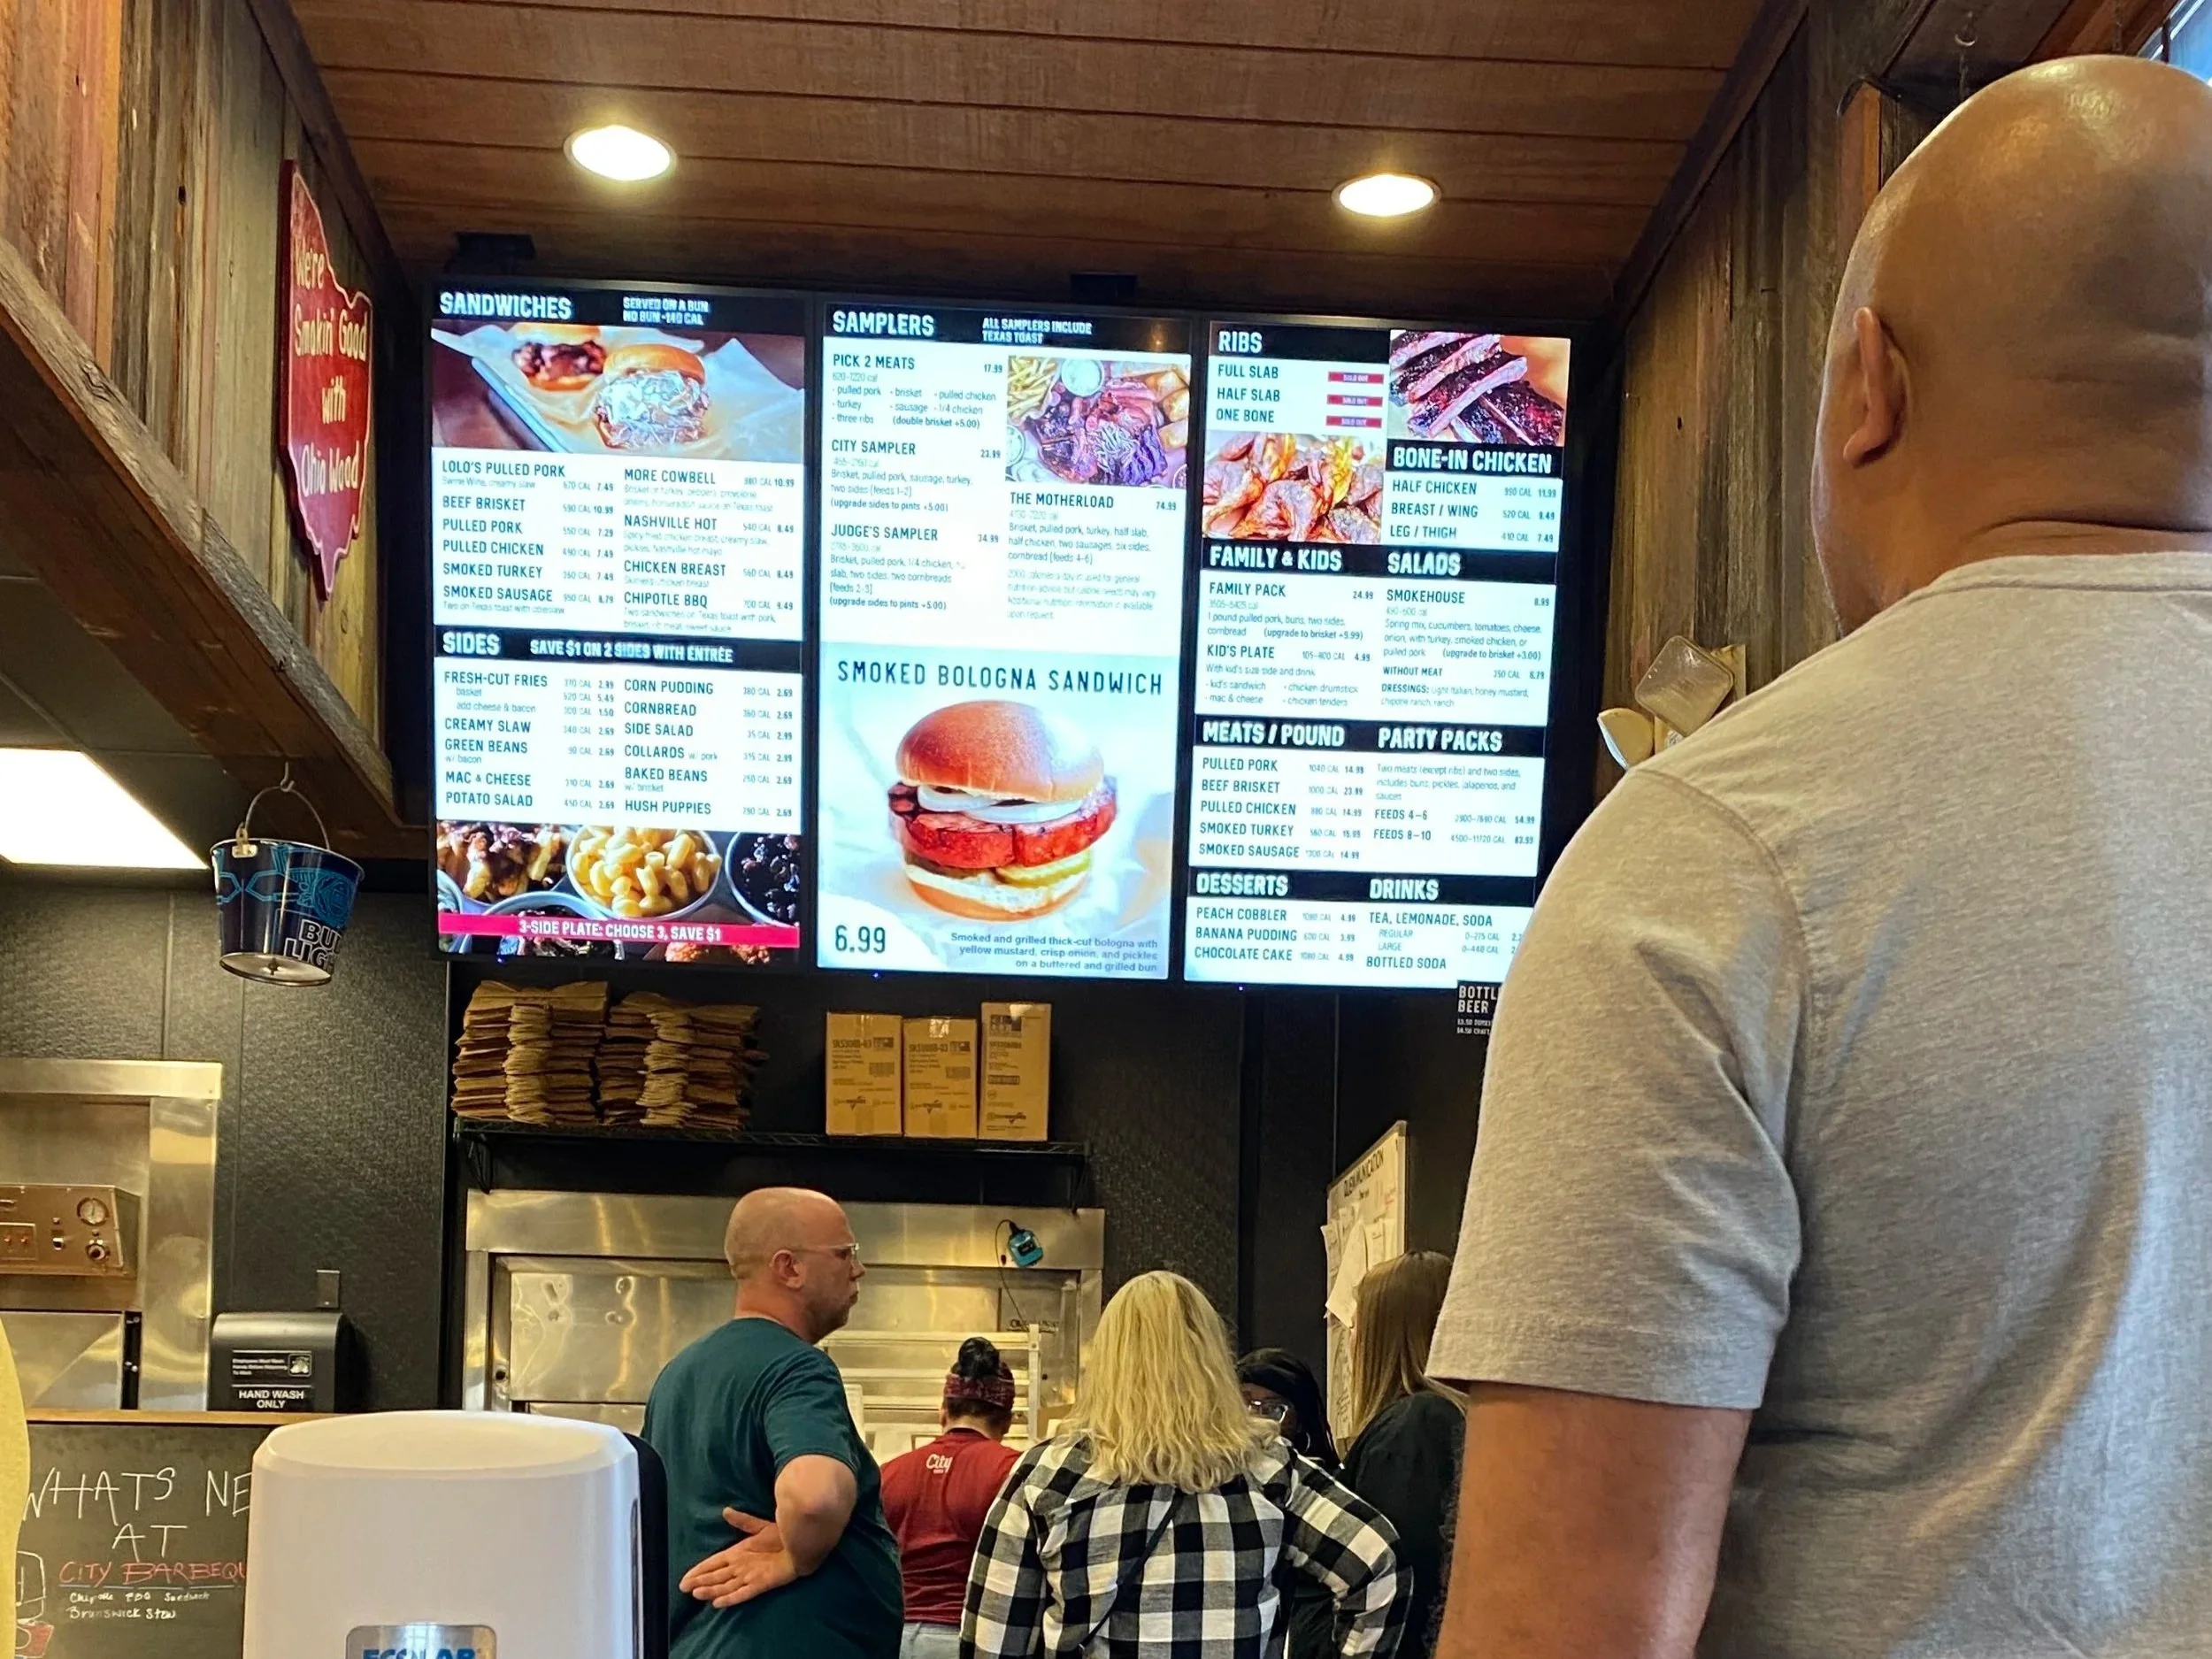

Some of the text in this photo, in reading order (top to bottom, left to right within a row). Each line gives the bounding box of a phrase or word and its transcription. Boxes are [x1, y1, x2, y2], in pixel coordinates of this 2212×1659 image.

[440, 292, 572, 319] SANDWICHES
[833, 311, 1091, 336] SAMPLERS ALL SAMPLERS INCLUDE
[339, 309, 367, 361] Good
[983, 330, 1042, 344] TEXAS TOAST
[1218, 331, 1263, 353] RIBS
[833, 354, 915, 370] PICK 2 MEATS
[1218, 365, 1279, 379] FULL SLAB
[322, 375, 346, 424] with
[1217, 388, 1279, 402] HALF SLAB
[1217, 408, 1274, 423] ONE BONE
[832, 440, 916, 455] CITY SAMPLER
[1394, 447, 1551, 473] BONE-IN CHICKEN
[301, 441, 359, 497] Ohio Wood
[442, 460, 565, 477] LOLO'S PULLED PORK
[625, 469, 716, 484] MORE COWBELL
[1393, 480, 1477, 495] HALF CHICKEN
[442, 495, 526, 511] BEEF BRISKET
[1010, 492, 1031, 504] THE
[1036, 493, 1114, 508] MOTHERLOAD
[1391, 503, 1478, 518] BREAST WING
[443, 518, 523, 534] PULLED PORK
[625, 515, 717, 530] NASHVILLE HOT
[832, 525, 938, 541] JUDGE'S SAMPLER
[1390, 526, 1456, 539] LEG THIGH
[443, 539, 543, 556] PULLED CHICKEN
[1210, 545, 1342, 571] FAMILY & KIDS
[1387, 551, 1461, 576] SALADS
[443, 563, 542, 579] SMOKED TURKEY
[624, 560, 726, 575] CHICKEN BREAST
[443, 586, 553, 602] SMOKED SAUSAGE
[1210, 582, 1286, 597] FAMILY PACK
[1386, 589, 1465, 603] SMOKEHOUSE
[624, 592, 708, 609] CHIPOTLE BBQ
[442, 632, 500, 655] SIDES
[530, 639, 565, 655] SAVE
[565, 640, 580, 657] $1
[583, 641, 602, 656] ON
[604, 641, 613, 657] 2
[615, 641, 650, 658] SIDES
[653, 644, 685, 660] WITH
[1207, 644, 1274, 658] KID'S PLATE
[444, 672, 548, 687] FRESH-CUT FRIES
[837, 661, 1162, 695] SMOKED BOLOGNA SANDWICH
[625, 680, 713, 695] CORN PUDDING
[625, 702, 696, 716] CORNBREAD
[445, 718, 531, 733] CREAMY SLAW
[625, 723, 693, 736] SIDE SALAD
[1202, 721, 1345, 747] MEATS / POUND
[1378, 727, 1502, 752] PARTY PACKS
[445, 739, 527, 753] GREEN BEANS
[446, 772, 471, 783] MAC
[487, 773, 531, 786] CHEESE
[1196, 872, 1287, 896] DESSERTS
[1370, 879, 1439, 901] DRINKS
[1196, 907, 1286, 921] PEACH COBBLER
[1370, 912, 1493, 926] TEA, LEMONADE, SODA
[519, 919, 721, 941] 3-SIDE PLATE: CHOOSE 3, SAVE $1
[1196, 927, 1297, 941] BANANA PUDDING
[835, 925, 886, 952] 6.99
[951, 933, 1157, 949] Smoked and grilled thick-cut bologna with
[959, 945, 992, 956] yellow
[994, 946, 1037, 956] mustard,
[1041, 949, 1065, 958] crisp
[1102, 949, 1119, 958] and
[1122, 950, 1157, 961] pickles
[1194, 947, 1292, 961] CHOCOLATE CAKE
[1040, 960, 1081, 969] buttered
[1104, 963, 1136, 972] grilled
[1139, 963, 1157, 972] bun
[1366, 956, 1446, 969] BOTTLED SODA
[1458, 1000, 1489, 1013] BEER
[926, 1454, 952, 1472] City
[112, 1524, 188, 1562] AT
[58, 1561, 112, 1588] CITY
